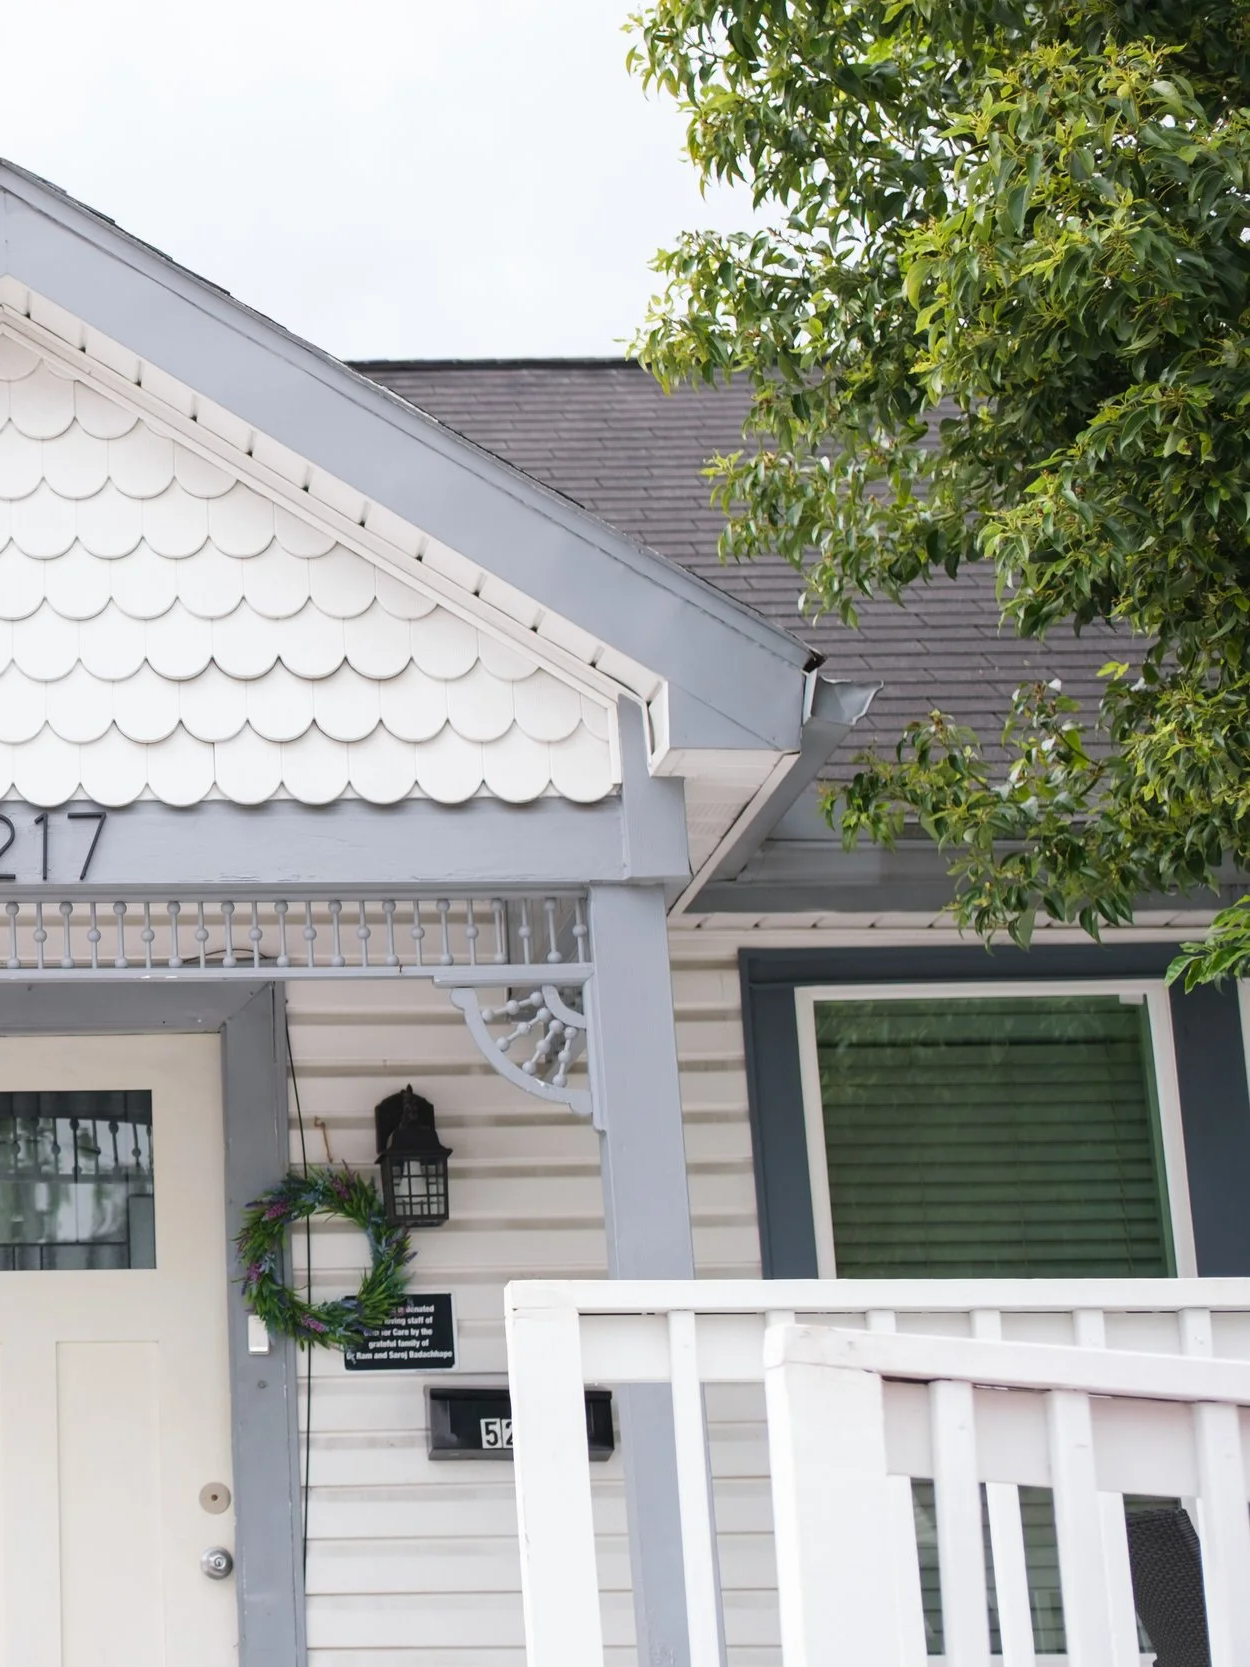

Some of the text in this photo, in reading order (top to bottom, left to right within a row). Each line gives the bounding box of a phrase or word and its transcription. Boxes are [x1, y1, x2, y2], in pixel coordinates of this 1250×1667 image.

[406, 1304, 435, 1313] donated
[407, 1316, 424, 1325] staff
[425, 1316, 433, 1325] of
[392, 1328, 409, 1337] Care
[410, 1328, 420, 1337] by
[421, 1327, 433, 1336] the
[368, 1338, 429, 1350] grateful family of
[356, 1351, 373, 1360] Ram
[373, 1351, 388, 1360] and
[389, 1350, 408, 1360] Saroj
